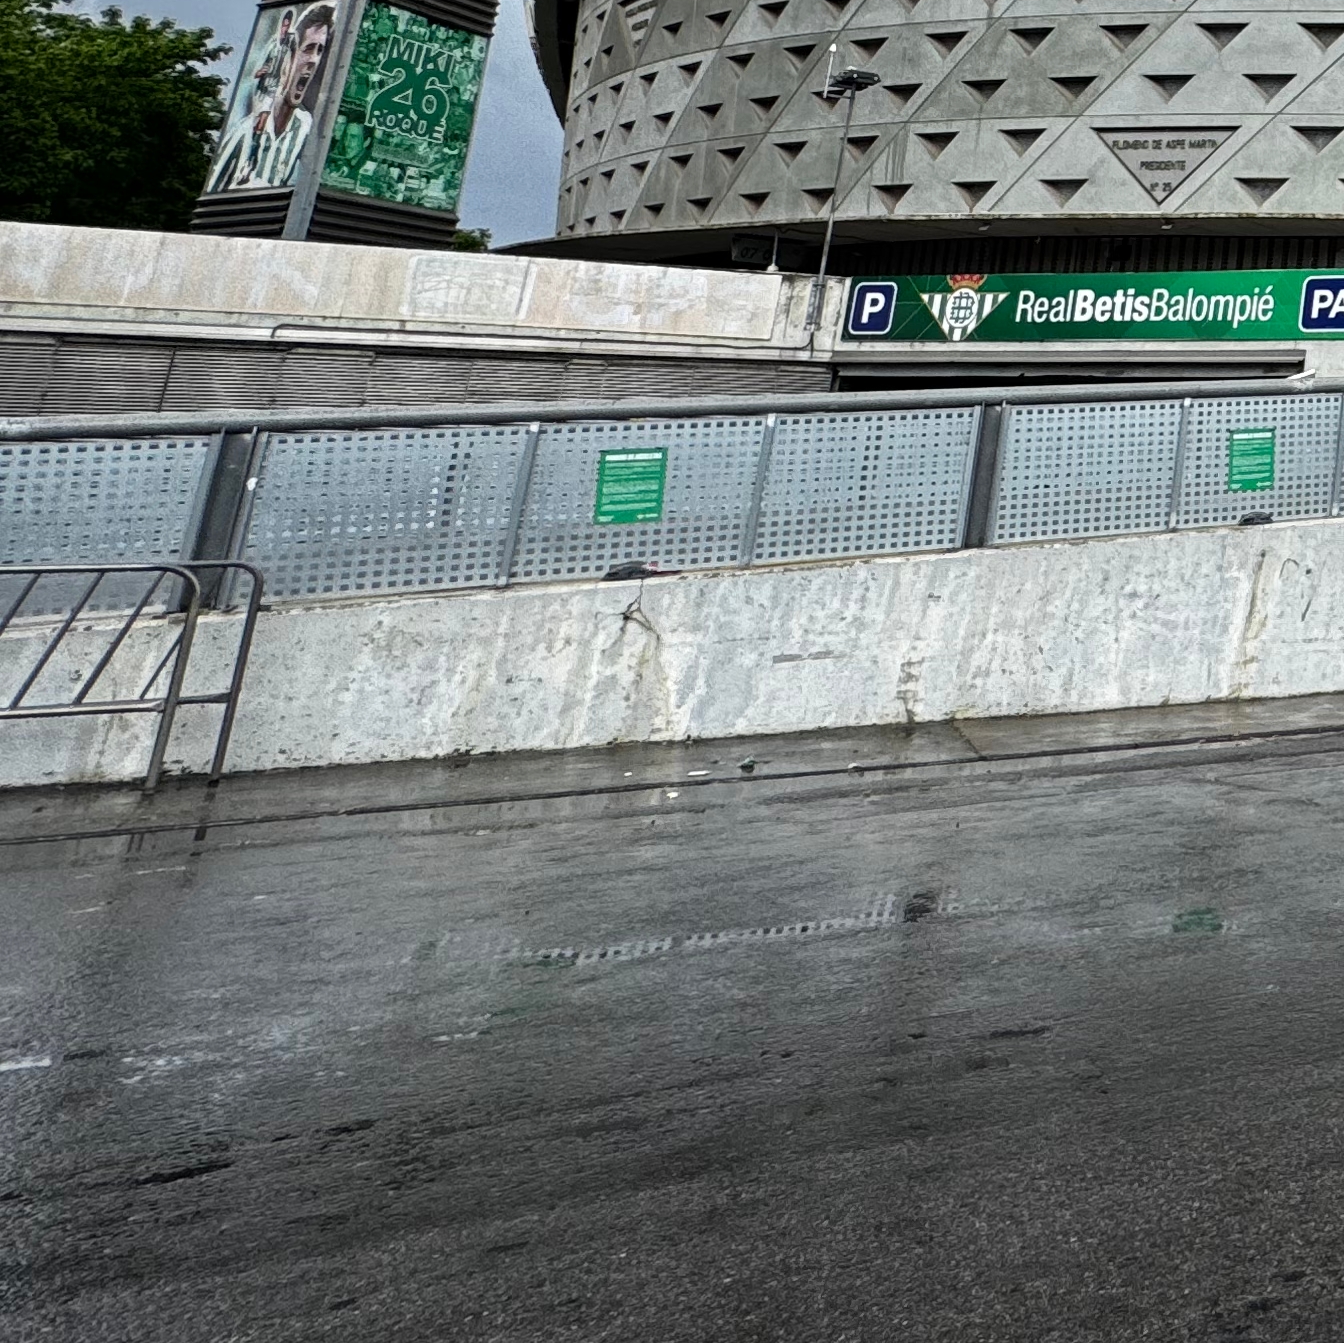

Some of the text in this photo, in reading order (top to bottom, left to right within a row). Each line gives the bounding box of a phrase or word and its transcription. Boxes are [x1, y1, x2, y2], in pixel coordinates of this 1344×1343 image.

[383, 34, 455, 79] MIKI
[364, 109, 447, 143] ROQUE
[861, 291, 886, 324] P
[1015, 284, 1275, 329] RealBetisBalompié
